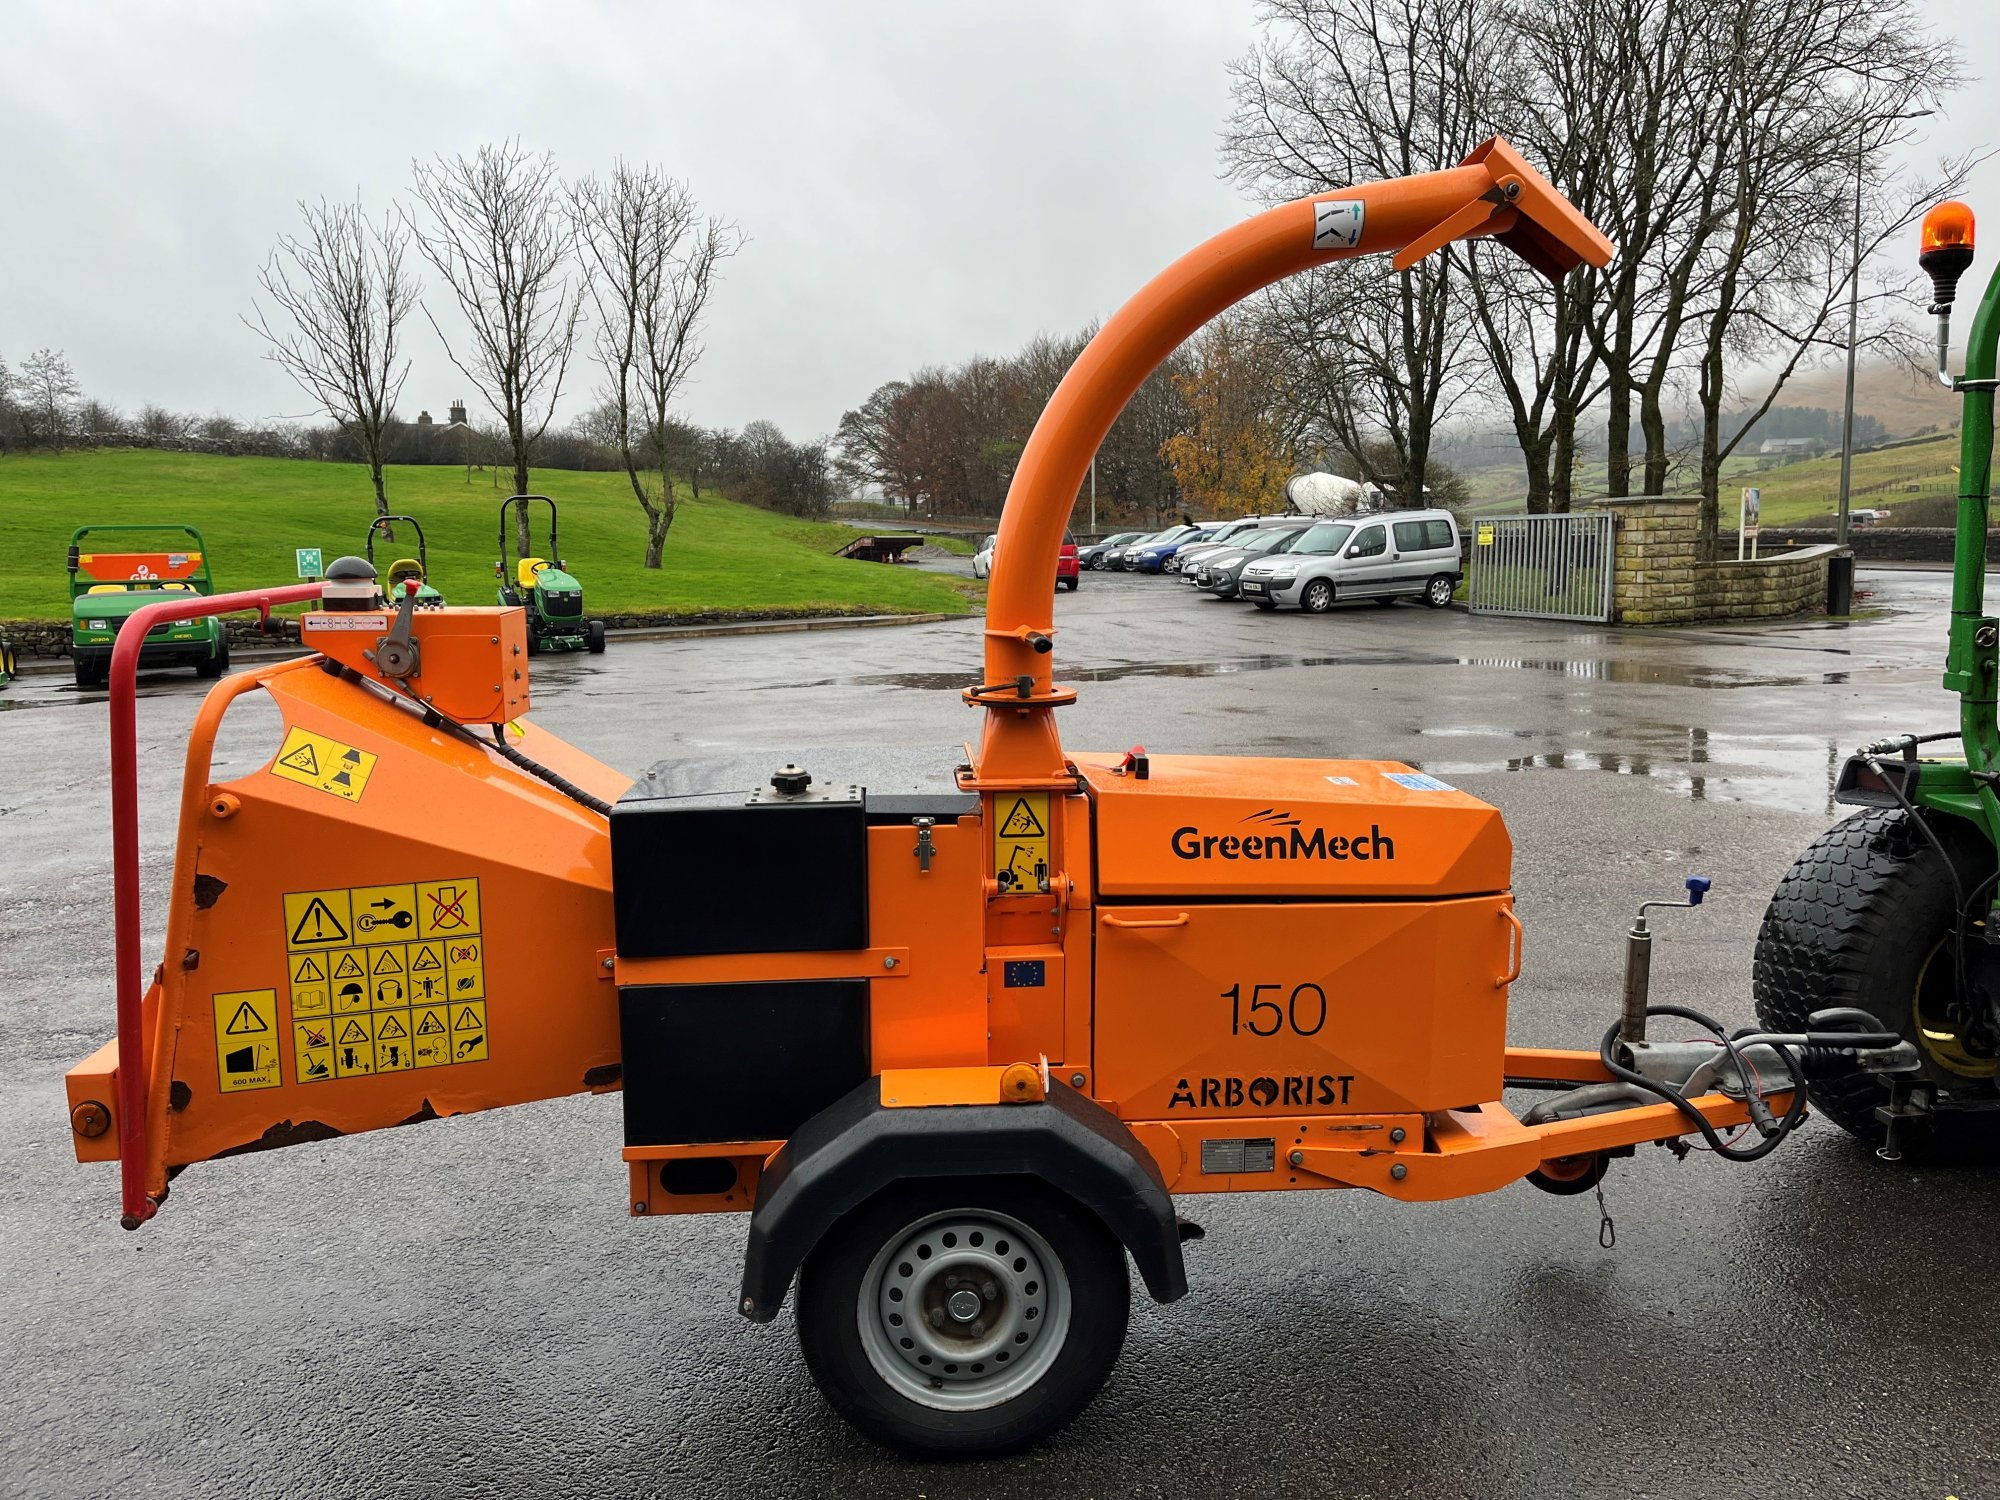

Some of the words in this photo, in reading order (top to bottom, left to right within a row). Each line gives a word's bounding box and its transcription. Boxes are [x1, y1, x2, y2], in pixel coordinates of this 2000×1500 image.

[1171, 824, 1395, 860] GreenMech
[1220, 982, 1327, 1037] 150
[232, 1078, 247, 1086] 600
[249, 1076, 267, 1084] MAX
[1168, 1074, 1355, 1109] ARBORIST
